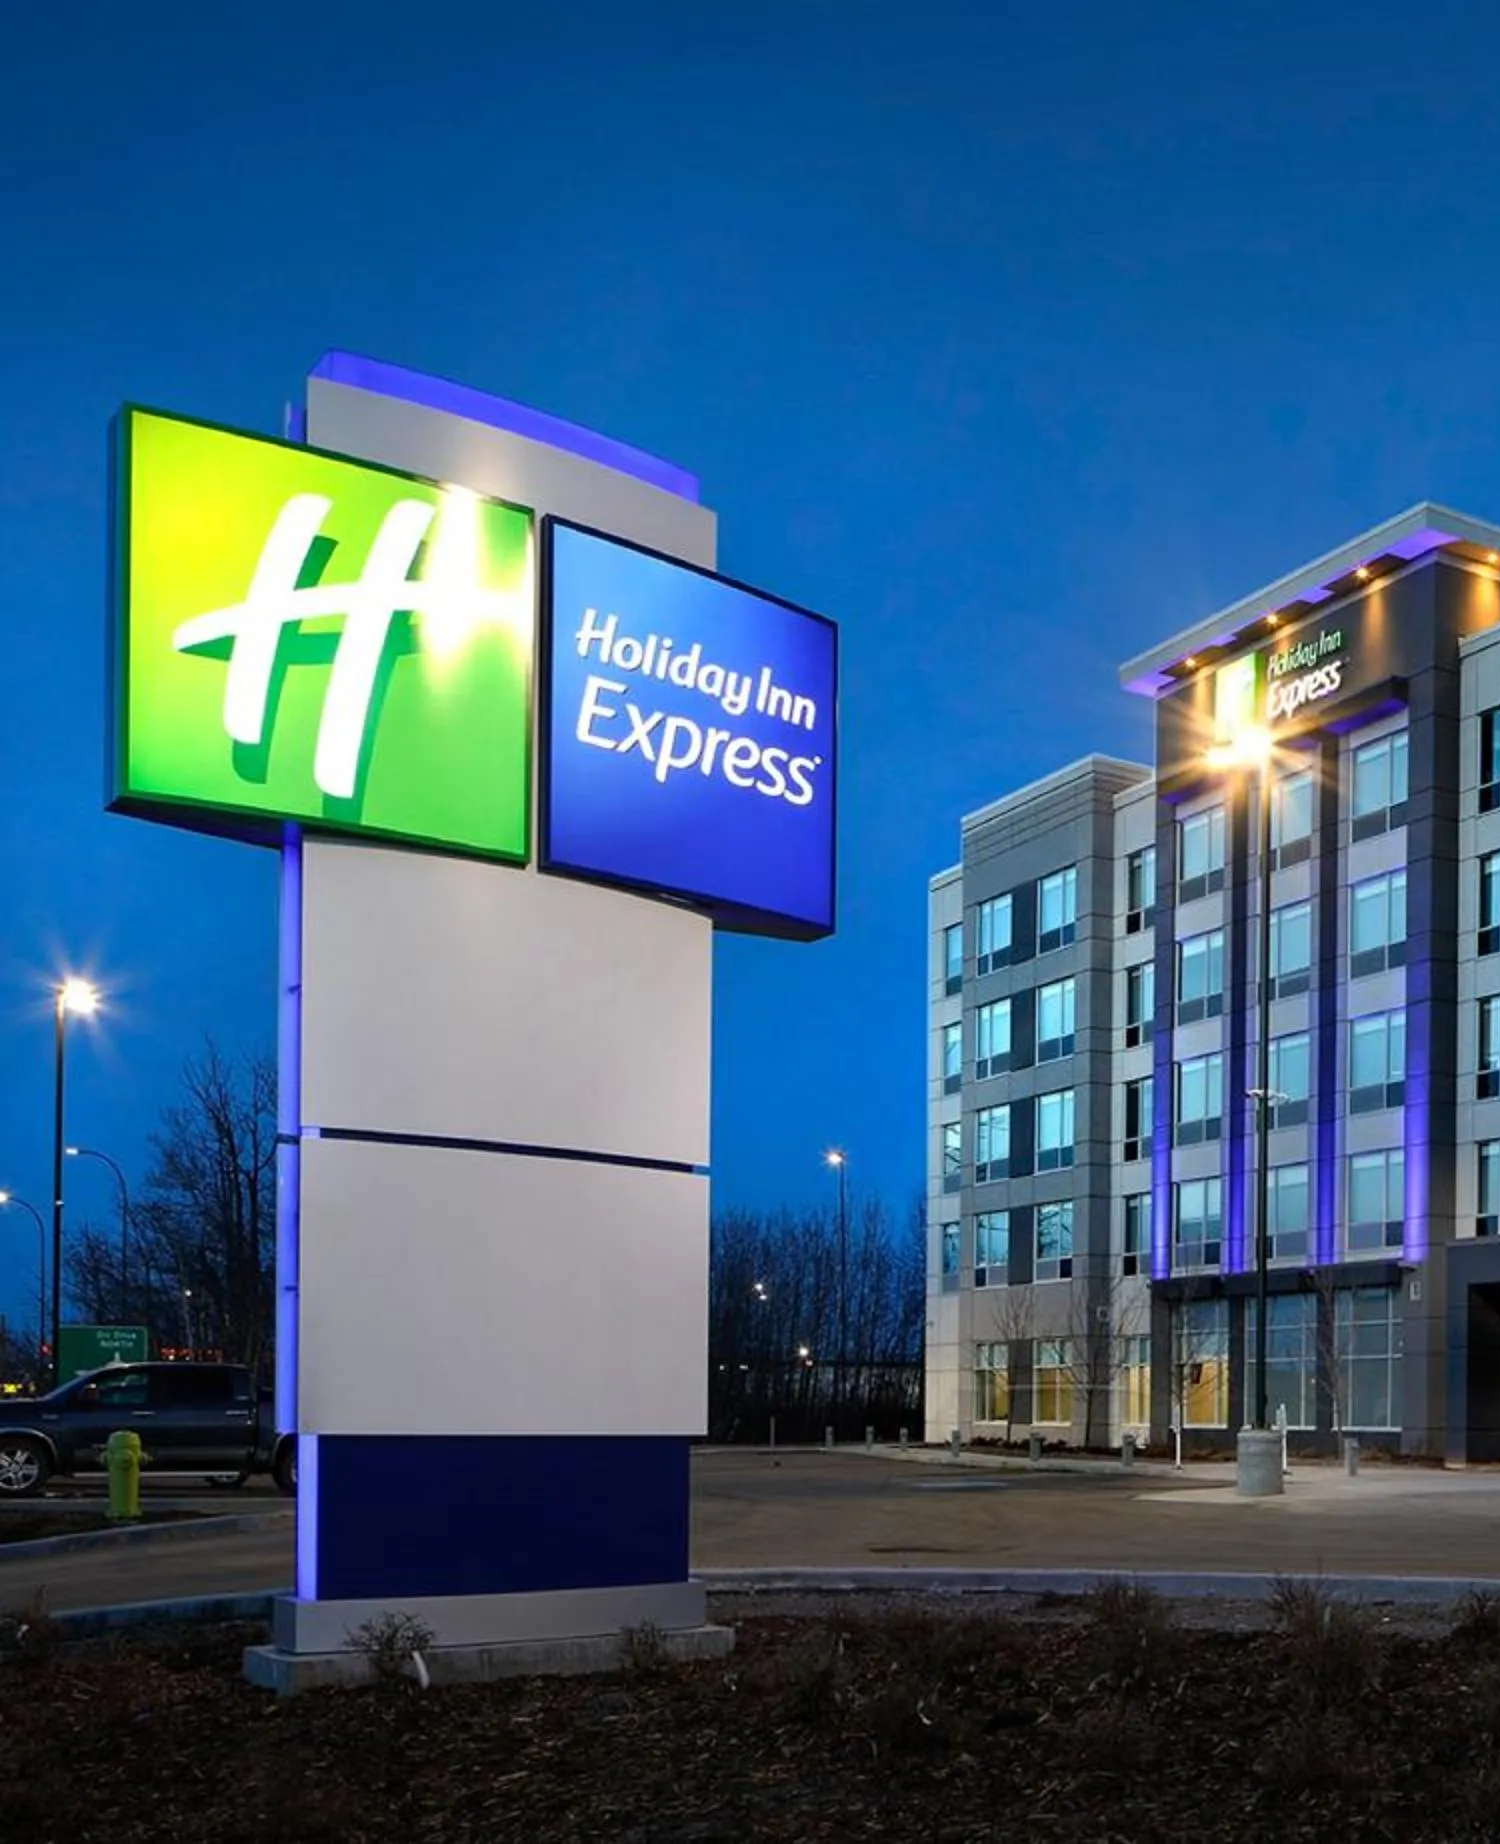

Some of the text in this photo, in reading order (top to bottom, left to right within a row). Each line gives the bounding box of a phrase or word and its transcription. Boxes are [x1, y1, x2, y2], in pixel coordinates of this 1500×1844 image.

[575, 607, 817, 731] Holiday Inn
[1266, 660, 1342, 720] Express
[1267, 629, 1341, 683] Holiday Inn
[575, 673, 815, 806] Express
